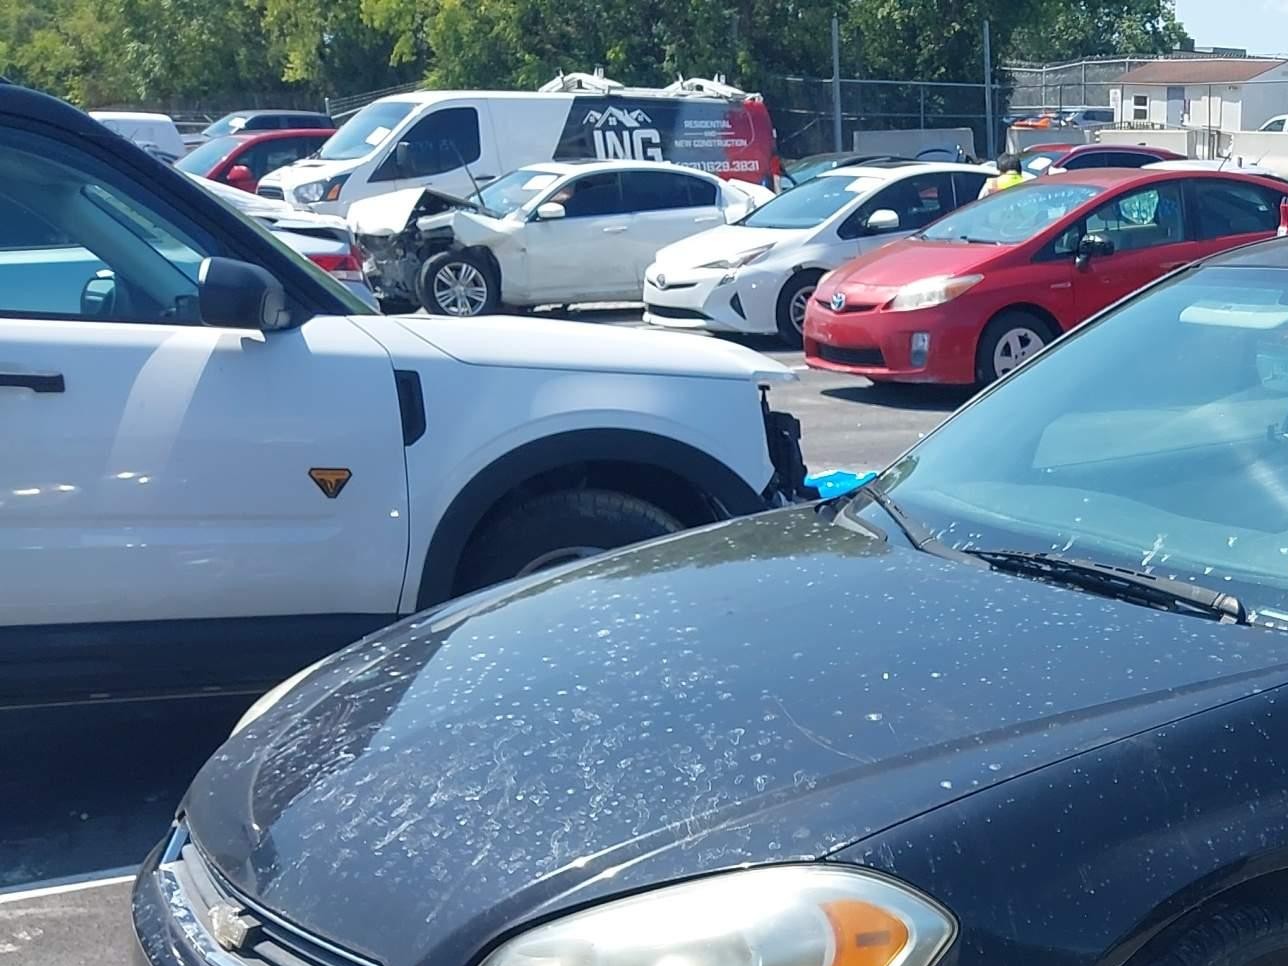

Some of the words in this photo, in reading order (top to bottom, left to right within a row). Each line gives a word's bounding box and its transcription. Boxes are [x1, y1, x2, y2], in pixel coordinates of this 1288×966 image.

[593, 129, 663, 162] ING
[674, 139, 692, 148] NEW
[693, 139, 748, 148] CONSTRUCTION
